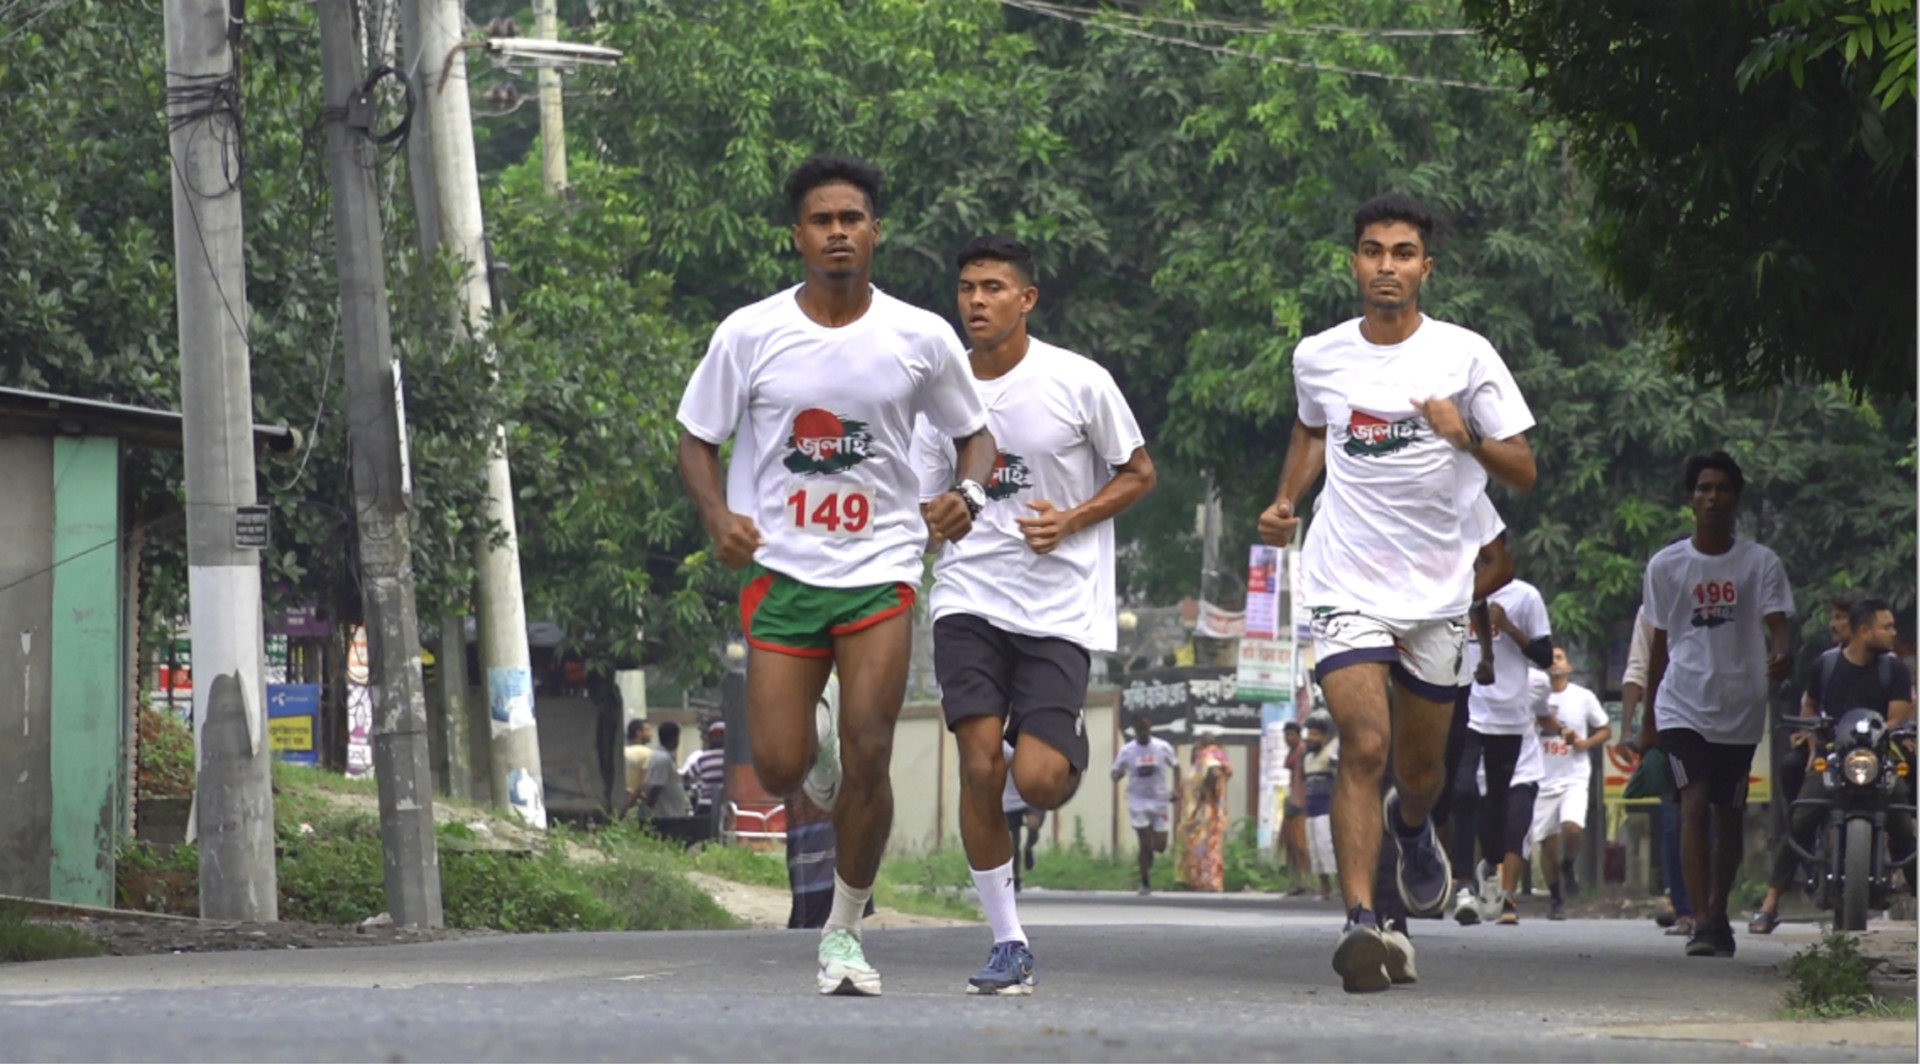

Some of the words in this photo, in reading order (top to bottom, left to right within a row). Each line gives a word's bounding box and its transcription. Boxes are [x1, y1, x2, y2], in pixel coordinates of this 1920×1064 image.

[796, 432, 867, 461] জুলাই
[787, 489, 870, 533] 149
[1692, 581, 1735, 605] 196
[1542, 740, 1569, 756] 195
